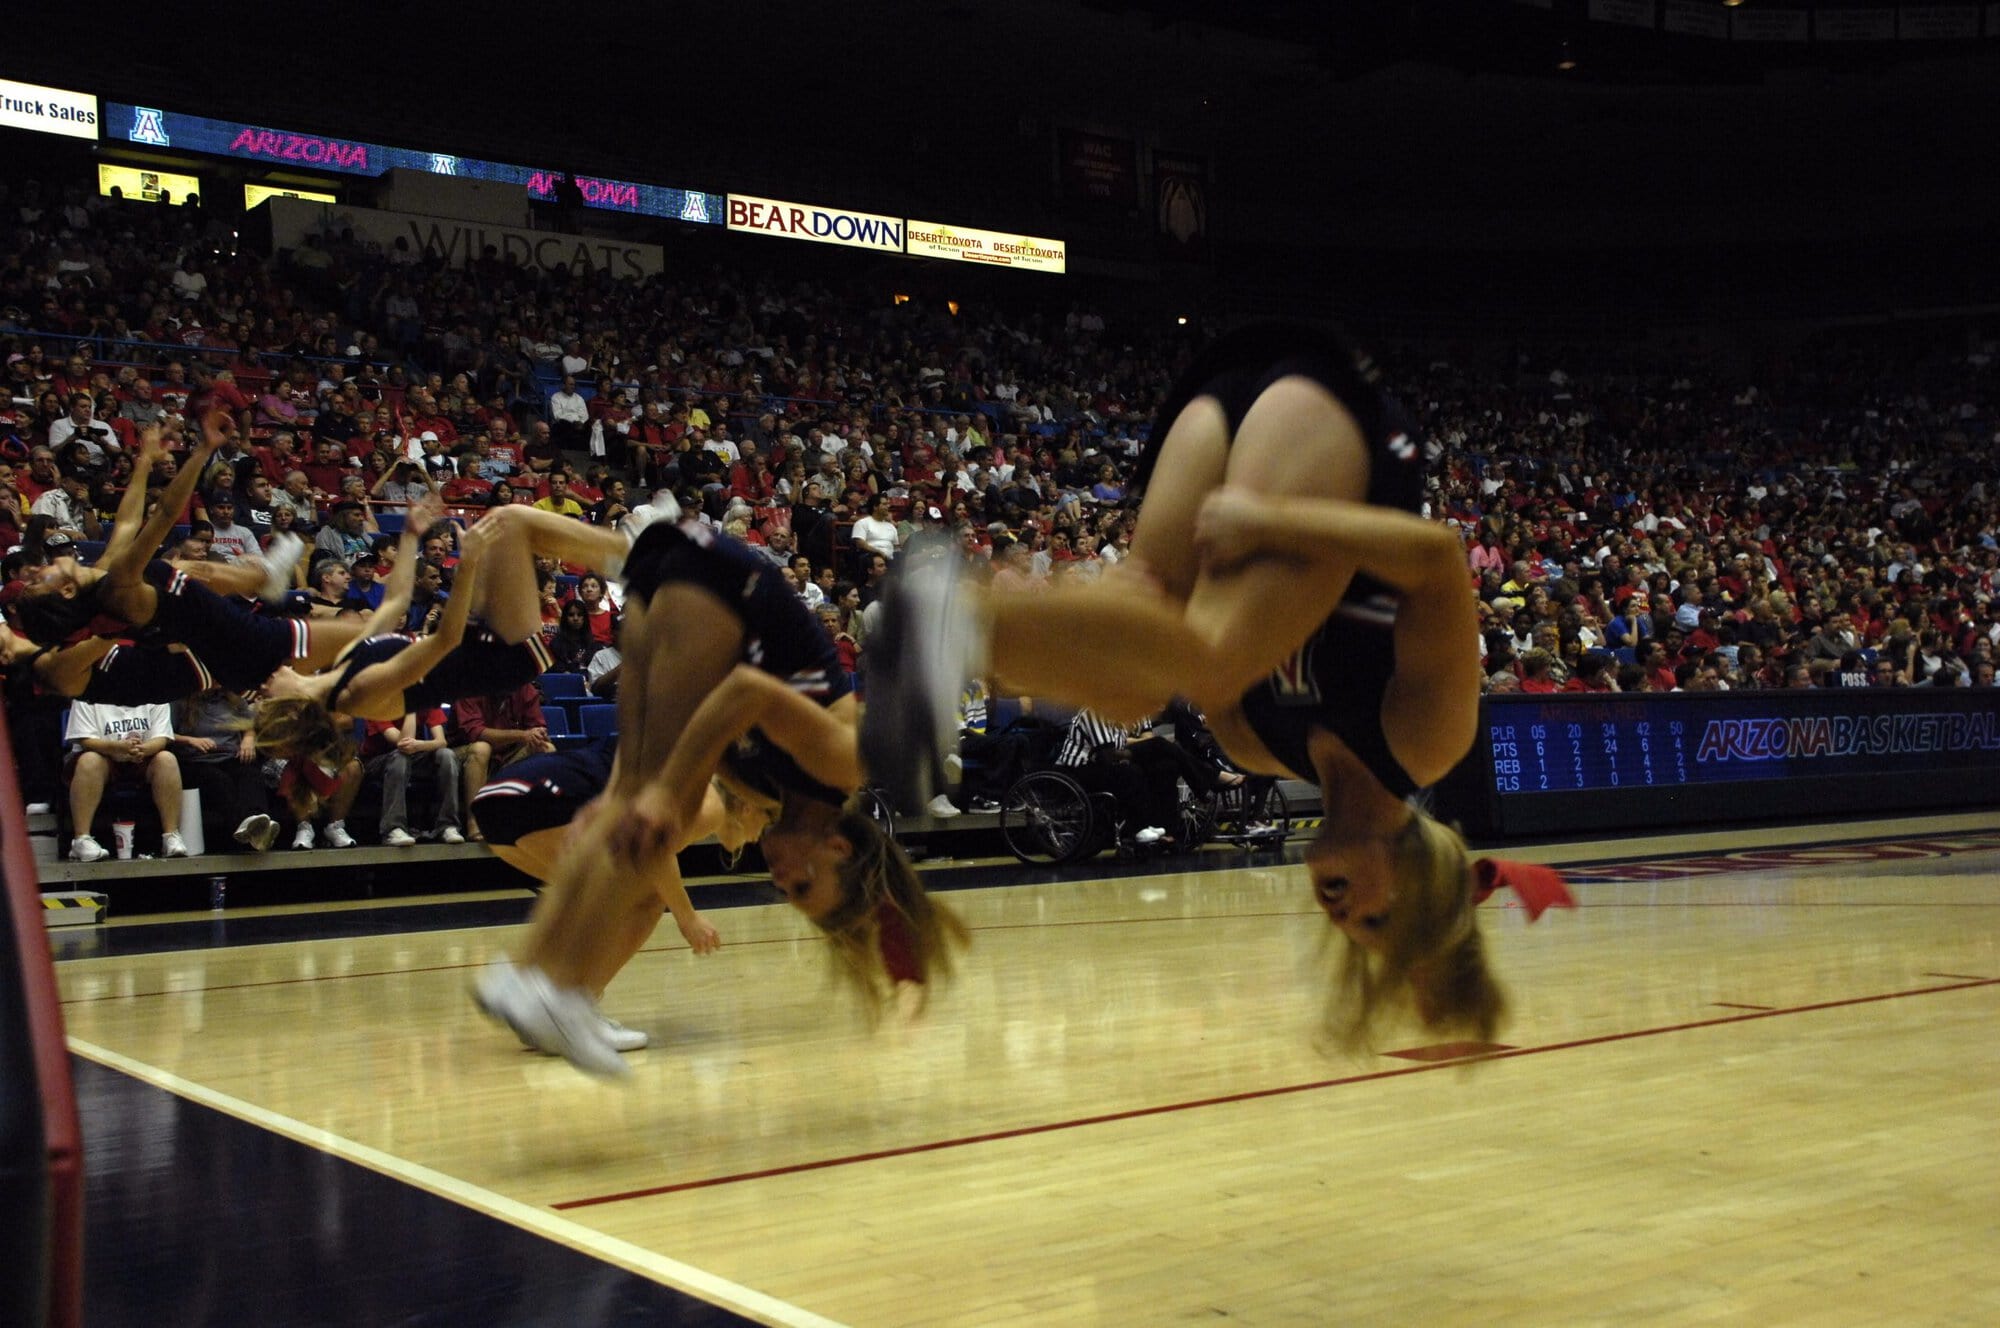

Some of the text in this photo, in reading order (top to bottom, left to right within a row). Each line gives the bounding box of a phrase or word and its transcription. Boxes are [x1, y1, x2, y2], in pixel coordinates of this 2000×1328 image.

[50, 103, 96, 124] Sales
[130, 106, 169, 146] A
[229, 128, 368, 170] ARIZONA
[681, 189, 709, 223] A
[908, 230, 983, 249] DESERT TOYOTA
[993, 242, 1064, 260] DESERT TOYOTA
[1490, 721, 1683, 741] PLR 05 20 34 42 50
[1492, 737, 1682, 757] PTS 6 2 24 6 4
[1494, 752, 1684, 774] REB 1 2 1 4 2
[1496, 768, 1686, 791] FLS 2 3 0 3 3
